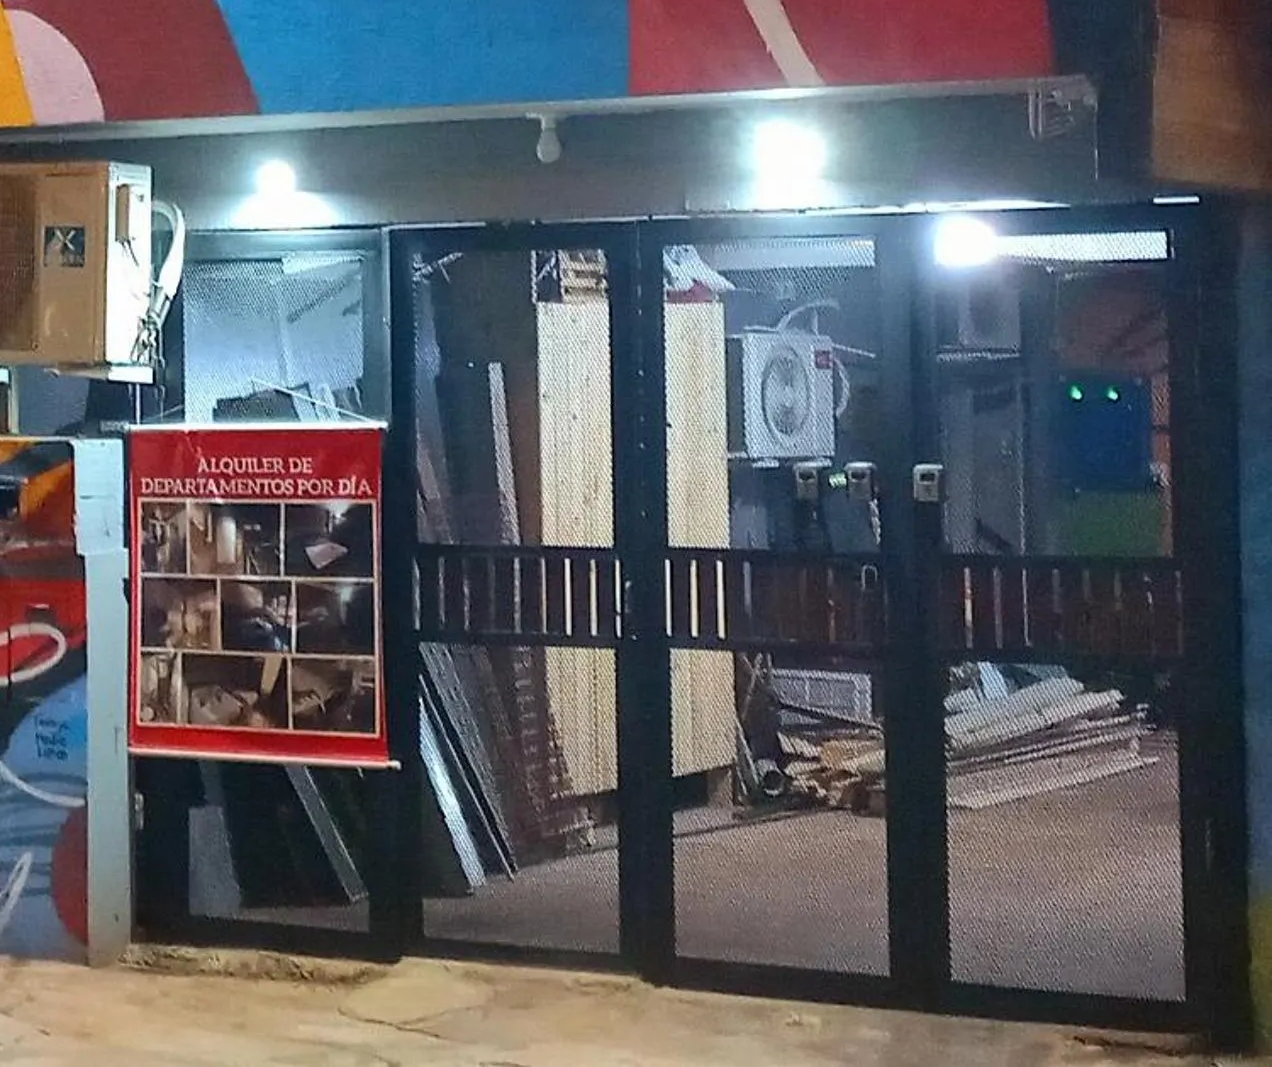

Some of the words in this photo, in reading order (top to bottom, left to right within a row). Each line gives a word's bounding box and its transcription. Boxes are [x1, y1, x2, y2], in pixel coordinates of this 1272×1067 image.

[197, 456, 285, 476] ALQUILER
[289, 457, 313, 474] DE
[140, 477, 293, 496] DEPARTAMENTOS
[297, 479, 334, 496] POR
[338, 474, 373, 496] DÍA
